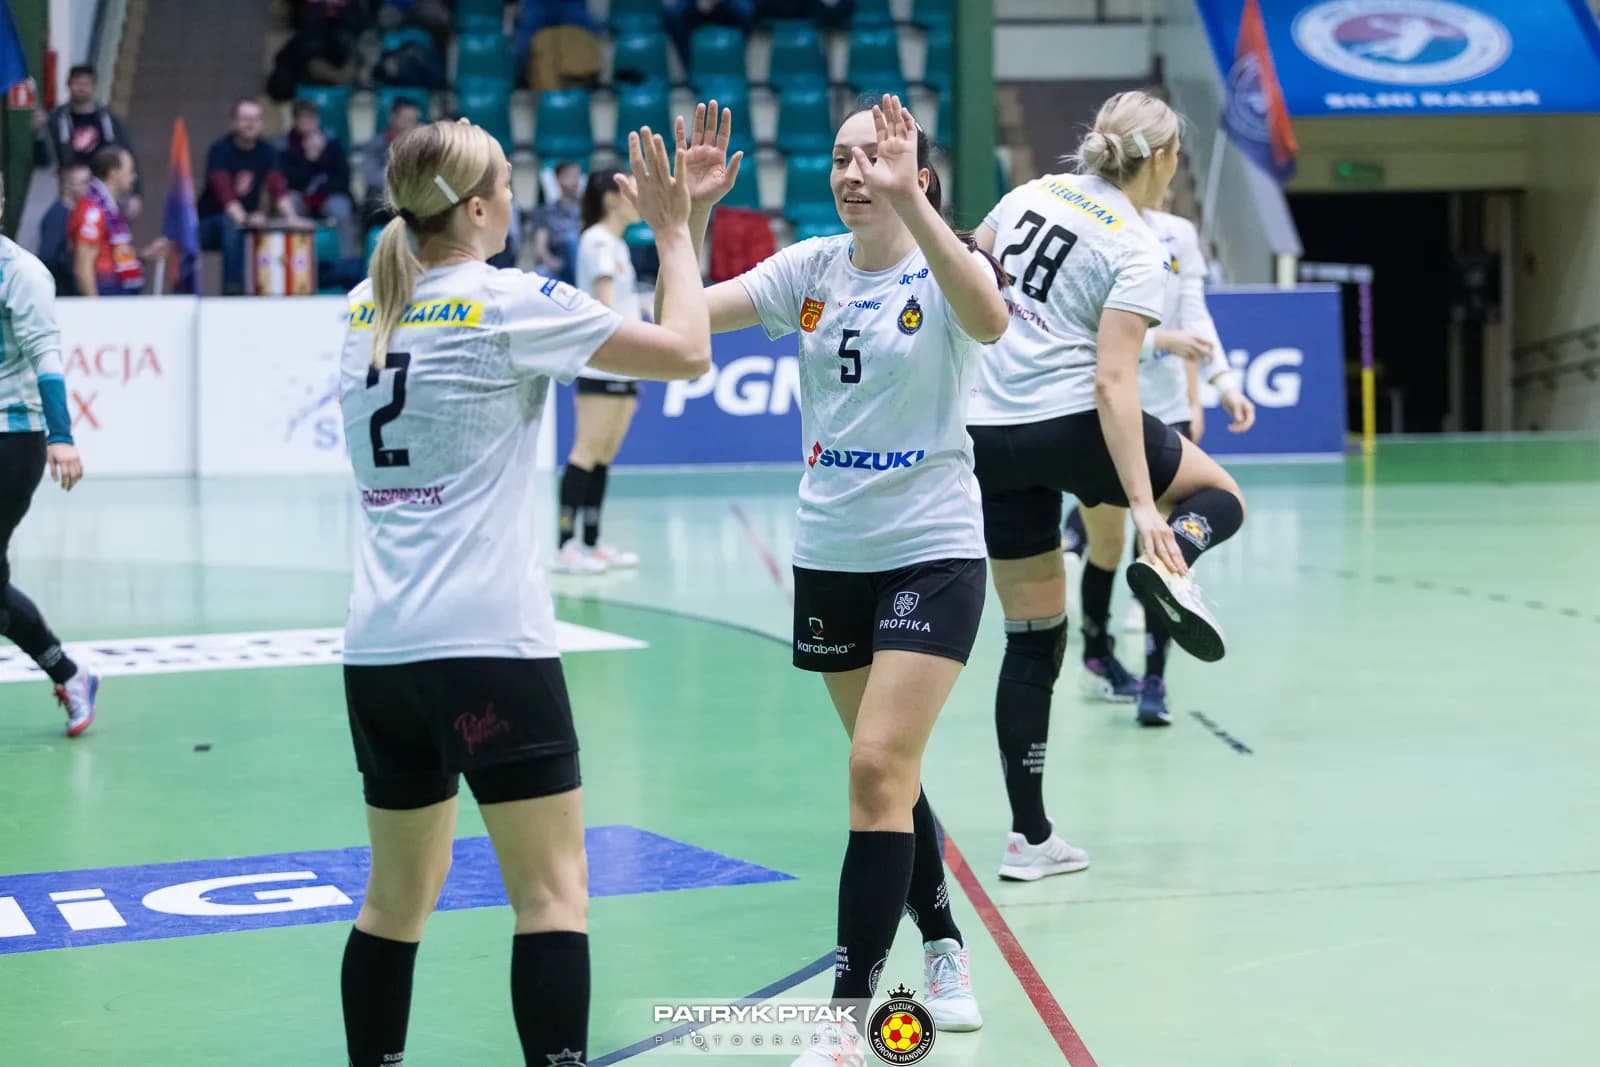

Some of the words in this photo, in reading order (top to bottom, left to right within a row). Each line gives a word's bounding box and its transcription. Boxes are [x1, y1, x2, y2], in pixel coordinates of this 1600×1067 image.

[999, 209, 1078, 303] 28
[65, 345, 163, 386] ACJA
[838, 328, 862, 384] 5
[366, 352, 411, 468] 2
[662, 356, 801, 418] PGN
[819, 449, 925, 471] SUZUKI
[797, 640, 848, 655] karabela
[879, 618, 932, 633] PROFIKA
